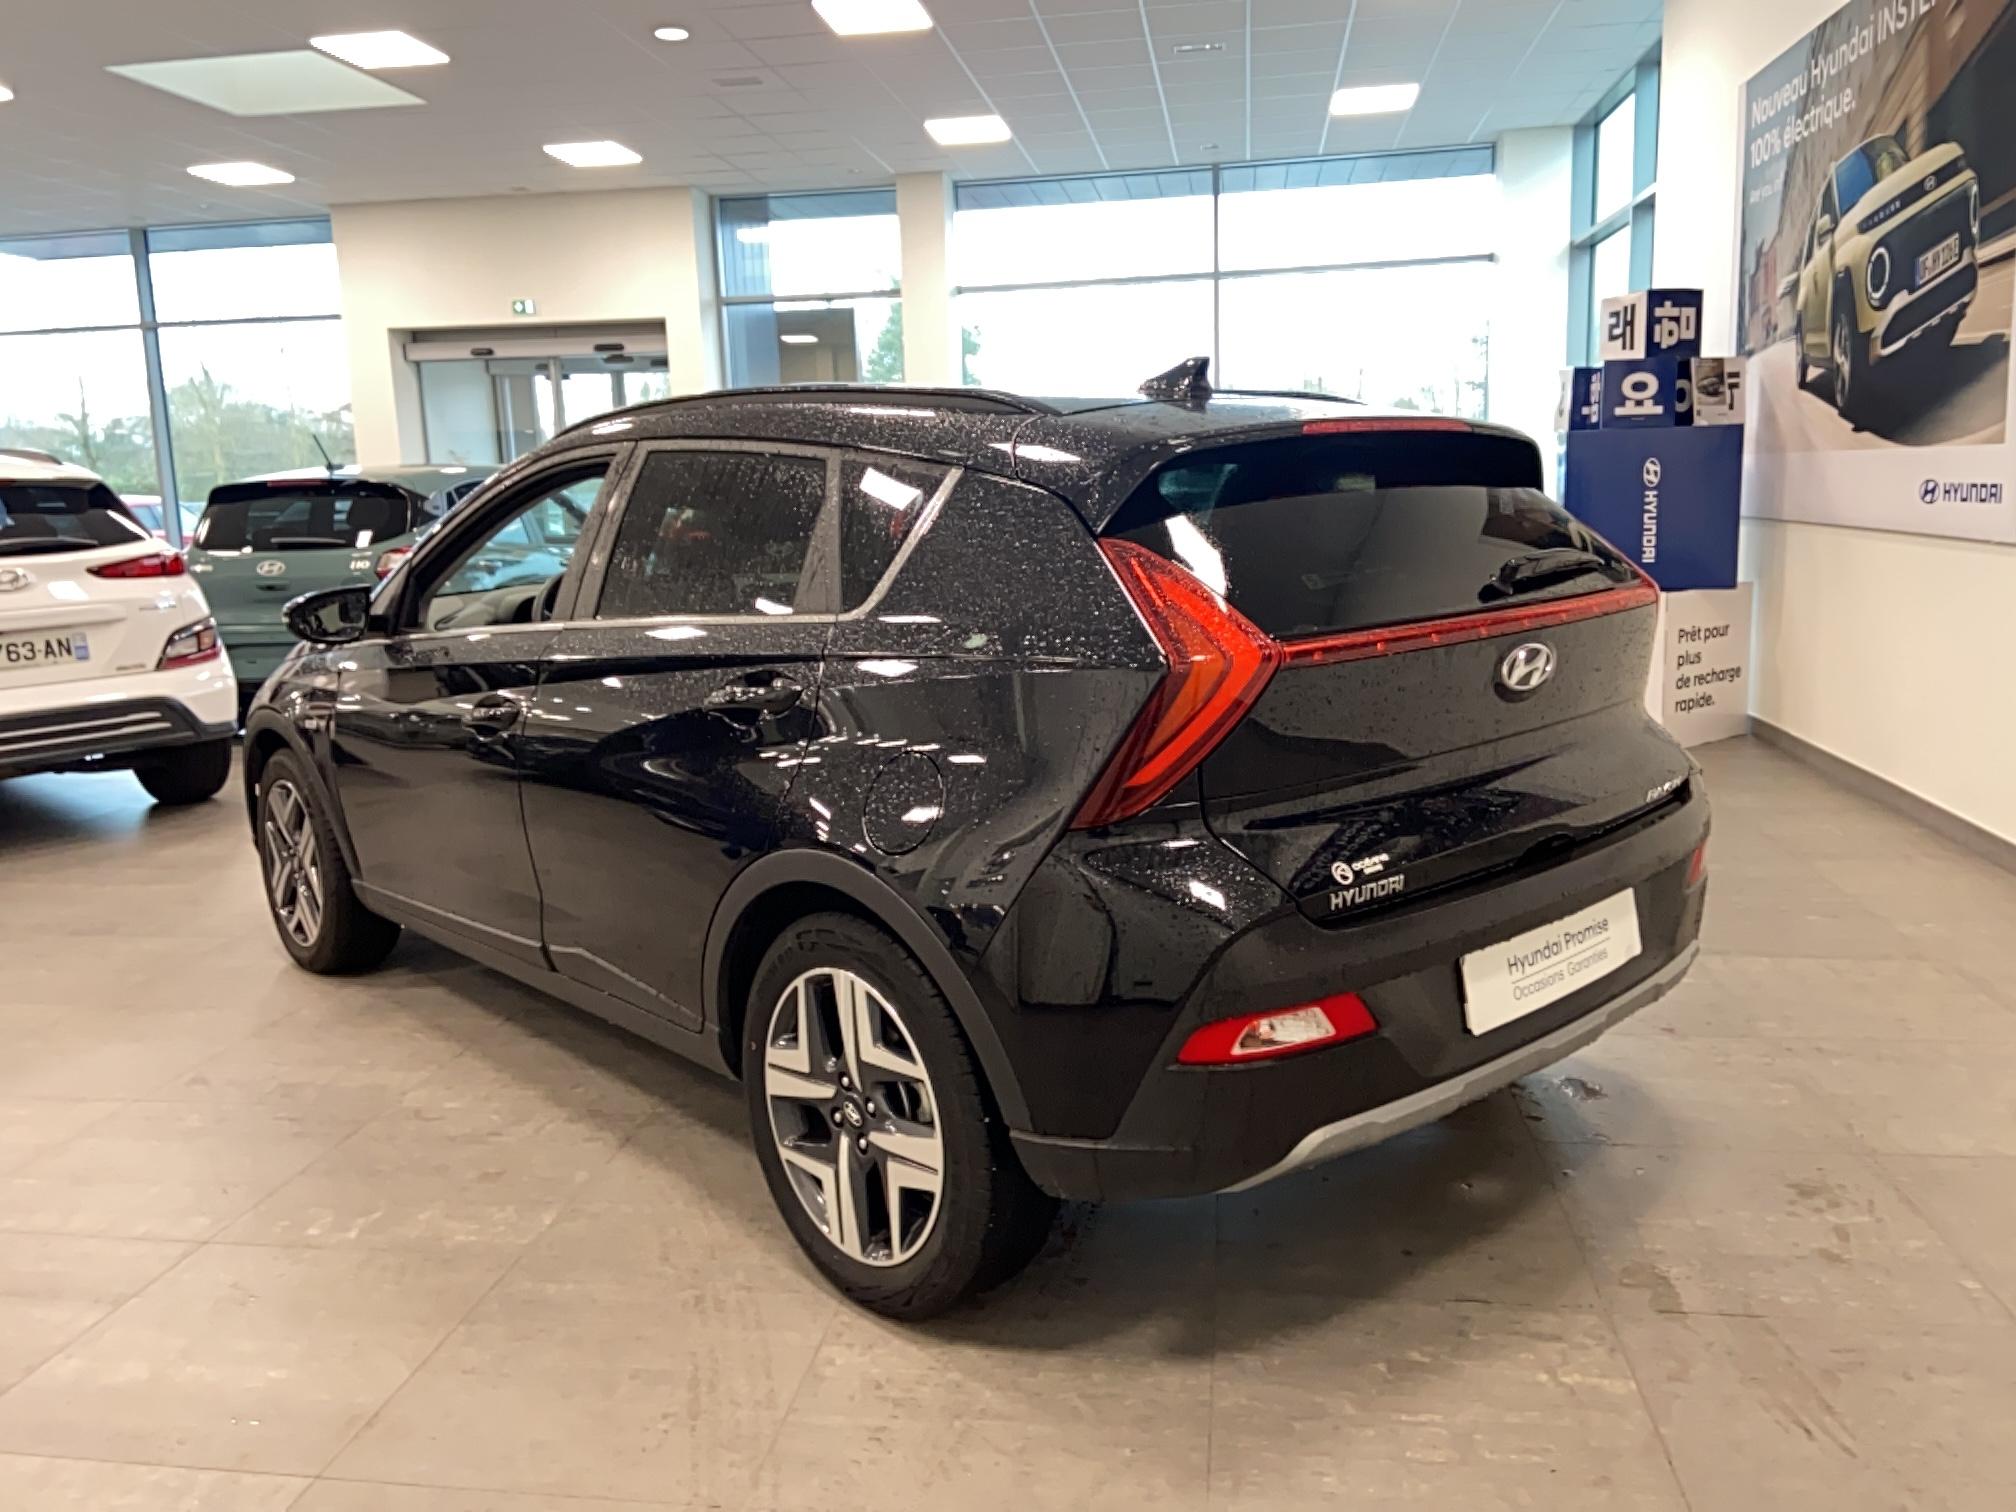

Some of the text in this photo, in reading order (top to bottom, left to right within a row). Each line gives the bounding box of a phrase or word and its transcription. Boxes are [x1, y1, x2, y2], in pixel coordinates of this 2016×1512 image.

[1751, 69, 1808, 128] Nouveau
[1810, 14, 1874, 89] Hyundai
[1750, 86, 1857, 169] 100% électrique.
[1942, 482, 2003, 504] HYUNDAI
[1641, 490, 1659, 563] HYUNDAI
[0, 637, 73, 662] 63-AN
[1678, 624, 1730, 644] Prêt pour
[1677, 649, 1702, 671] plus
[1675, 665, 1742, 690] de recharge
[1674, 691, 1715, 713] rapide.
[1329, 872, 1405, 912] HYUNDAI
[1506, 917, 1610, 976] Hyundai Promise
[1512, 946, 1609, 1001] Occasions Garanties
